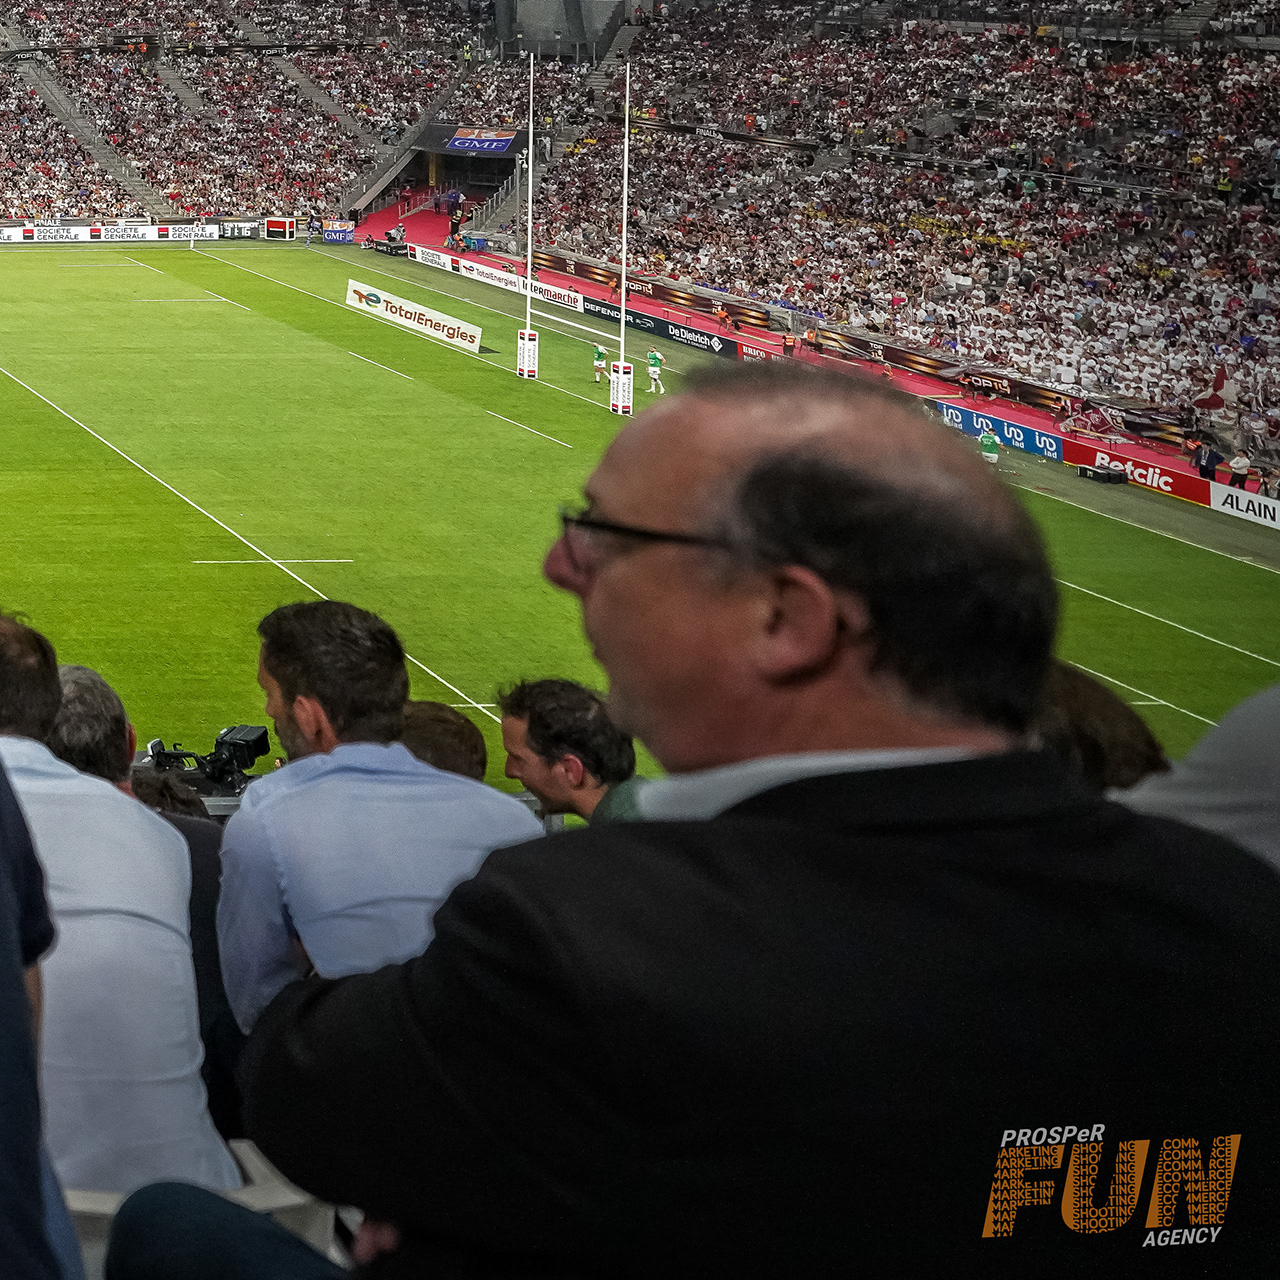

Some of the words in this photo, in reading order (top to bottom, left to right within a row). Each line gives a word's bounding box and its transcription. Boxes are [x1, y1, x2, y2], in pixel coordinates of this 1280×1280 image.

[454, 140, 506, 149] GMF
[324, 231, 346, 240] GMF
[420, 250, 442, 260] SOCIETE
[420, 256, 446, 268] GENERALE
[476, 268, 517, 288] TotalEnergies
[384, 299, 476, 344] TotalEnergies
[668, 325, 680, 337] De
[680, 328, 710, 346] Dietrich
[742, 346, 766, 359] BRICO
[972, 376, 1010, 394] OP14
[1222, 492, 1276, 522] ALAIN
